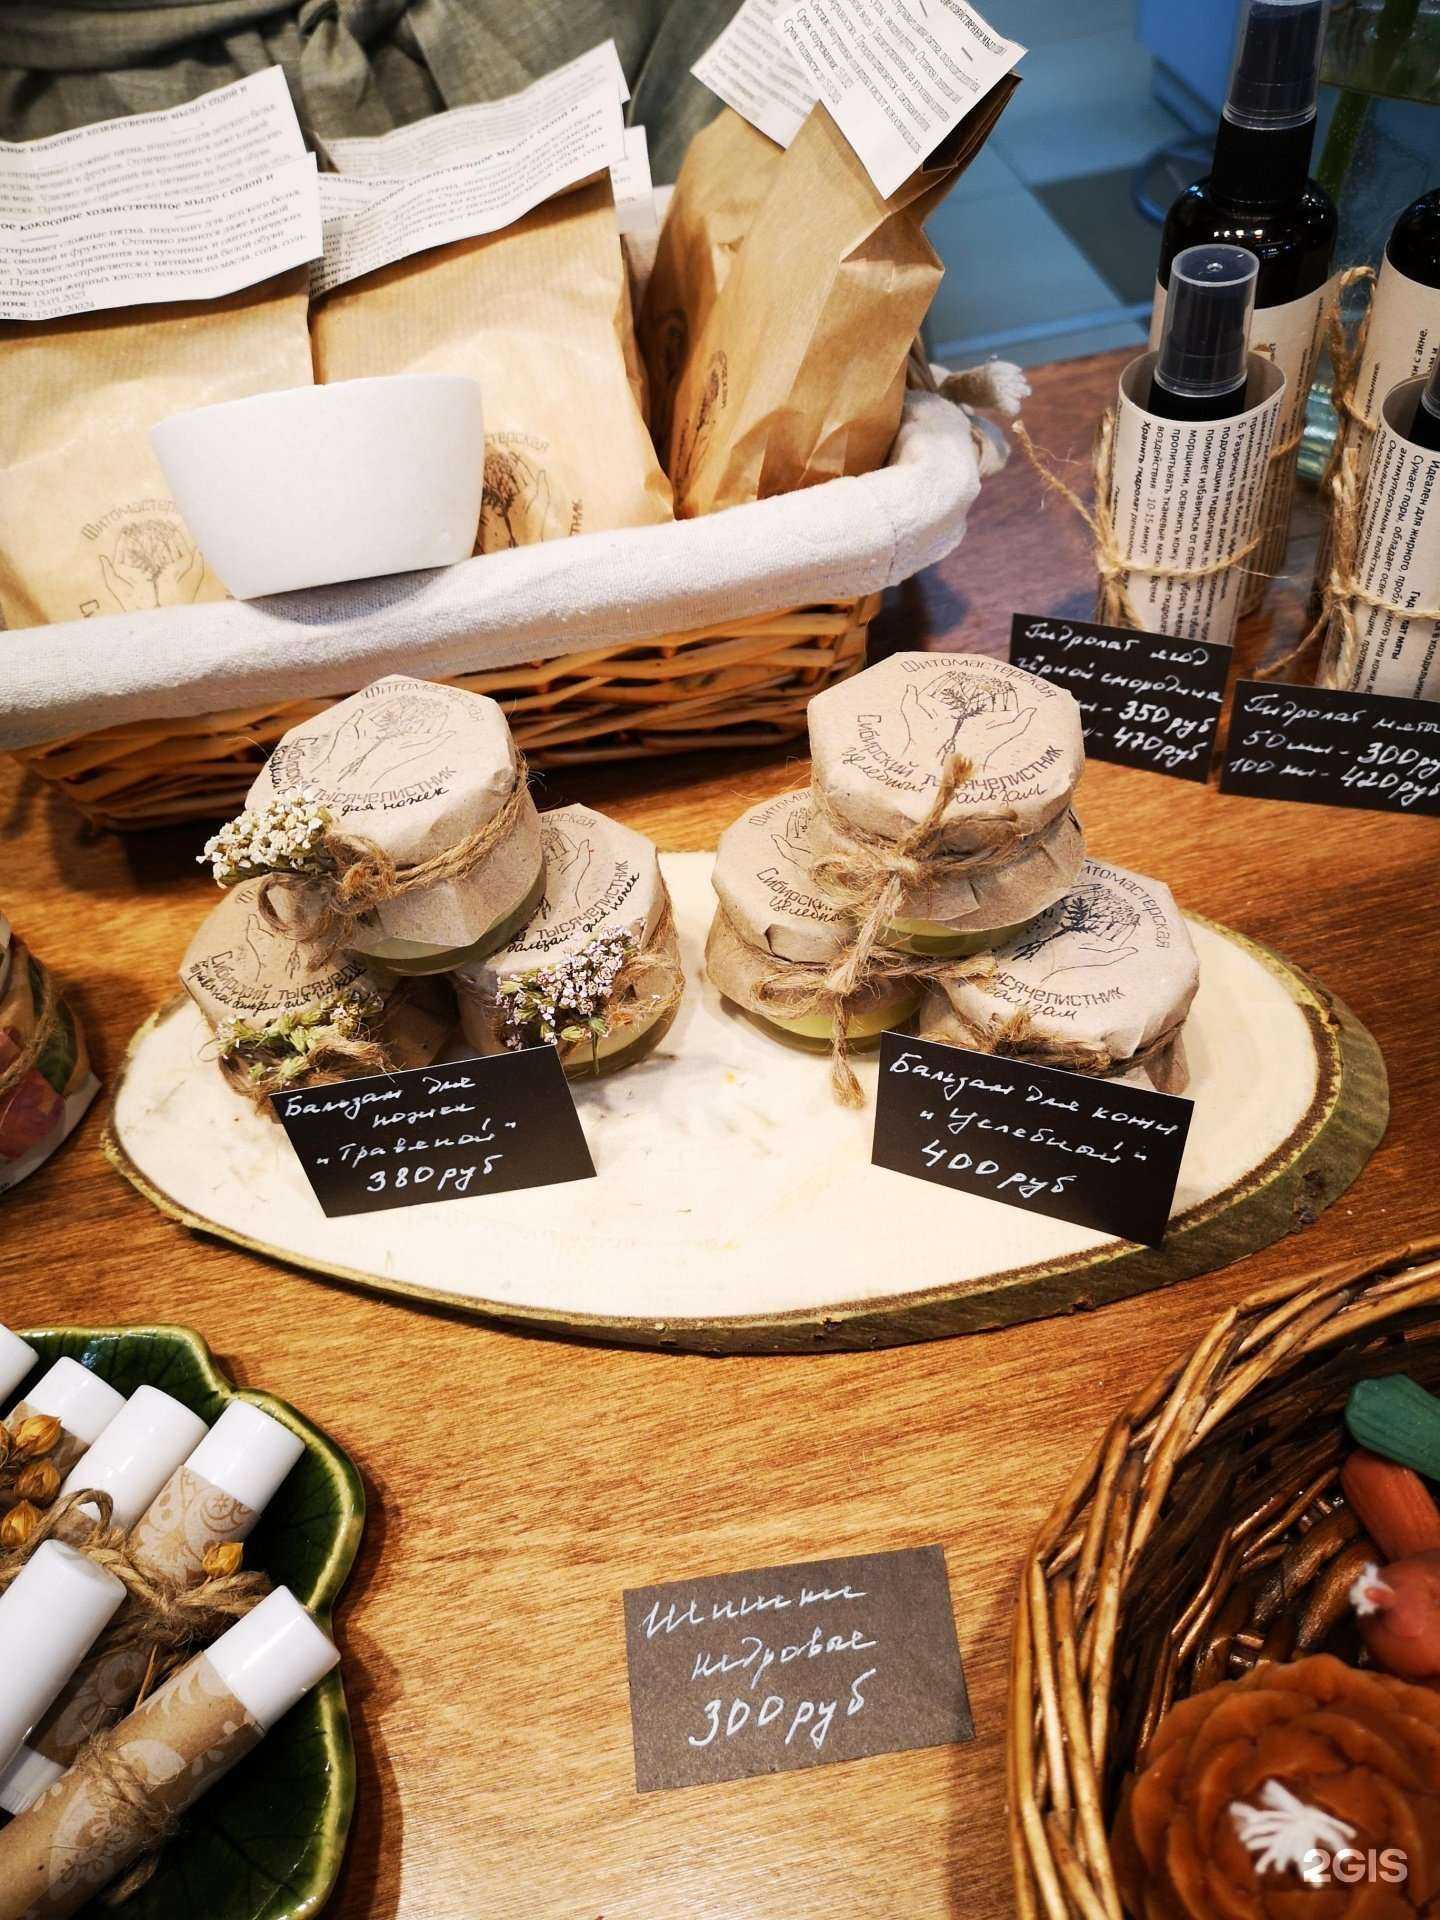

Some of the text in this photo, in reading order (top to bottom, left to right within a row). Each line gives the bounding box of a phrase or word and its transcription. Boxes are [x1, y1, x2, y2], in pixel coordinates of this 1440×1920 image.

[1138, 420, 1150, 464] Хранить
[1149, 425, 1164, 488] воздействия
[1162, 428, 1181, 493] пропитывать
[1180, 428, 1198, 487] морщинки,
[1199, 428, 1215, 475] поможет
[1132, 465, 1144, 511] гидролат
[1377, 439, 1397, 497] Оказывает
[1379, 446, 1408, 535] антикуперозным
[1406, 455, 1425, 497] Сужает
[1157, 496, 1171, 541] тканевые
[1173, 489, 1189, 534] освежить
[1190, 477, 1208, 532] избавиться
[1413, 506, 1425, 527] для
[1384, 526, 1403, 569] обладает
[1400, 528, 1420, 573] жирного,
[1391, 634, 1405, 660] мяты
